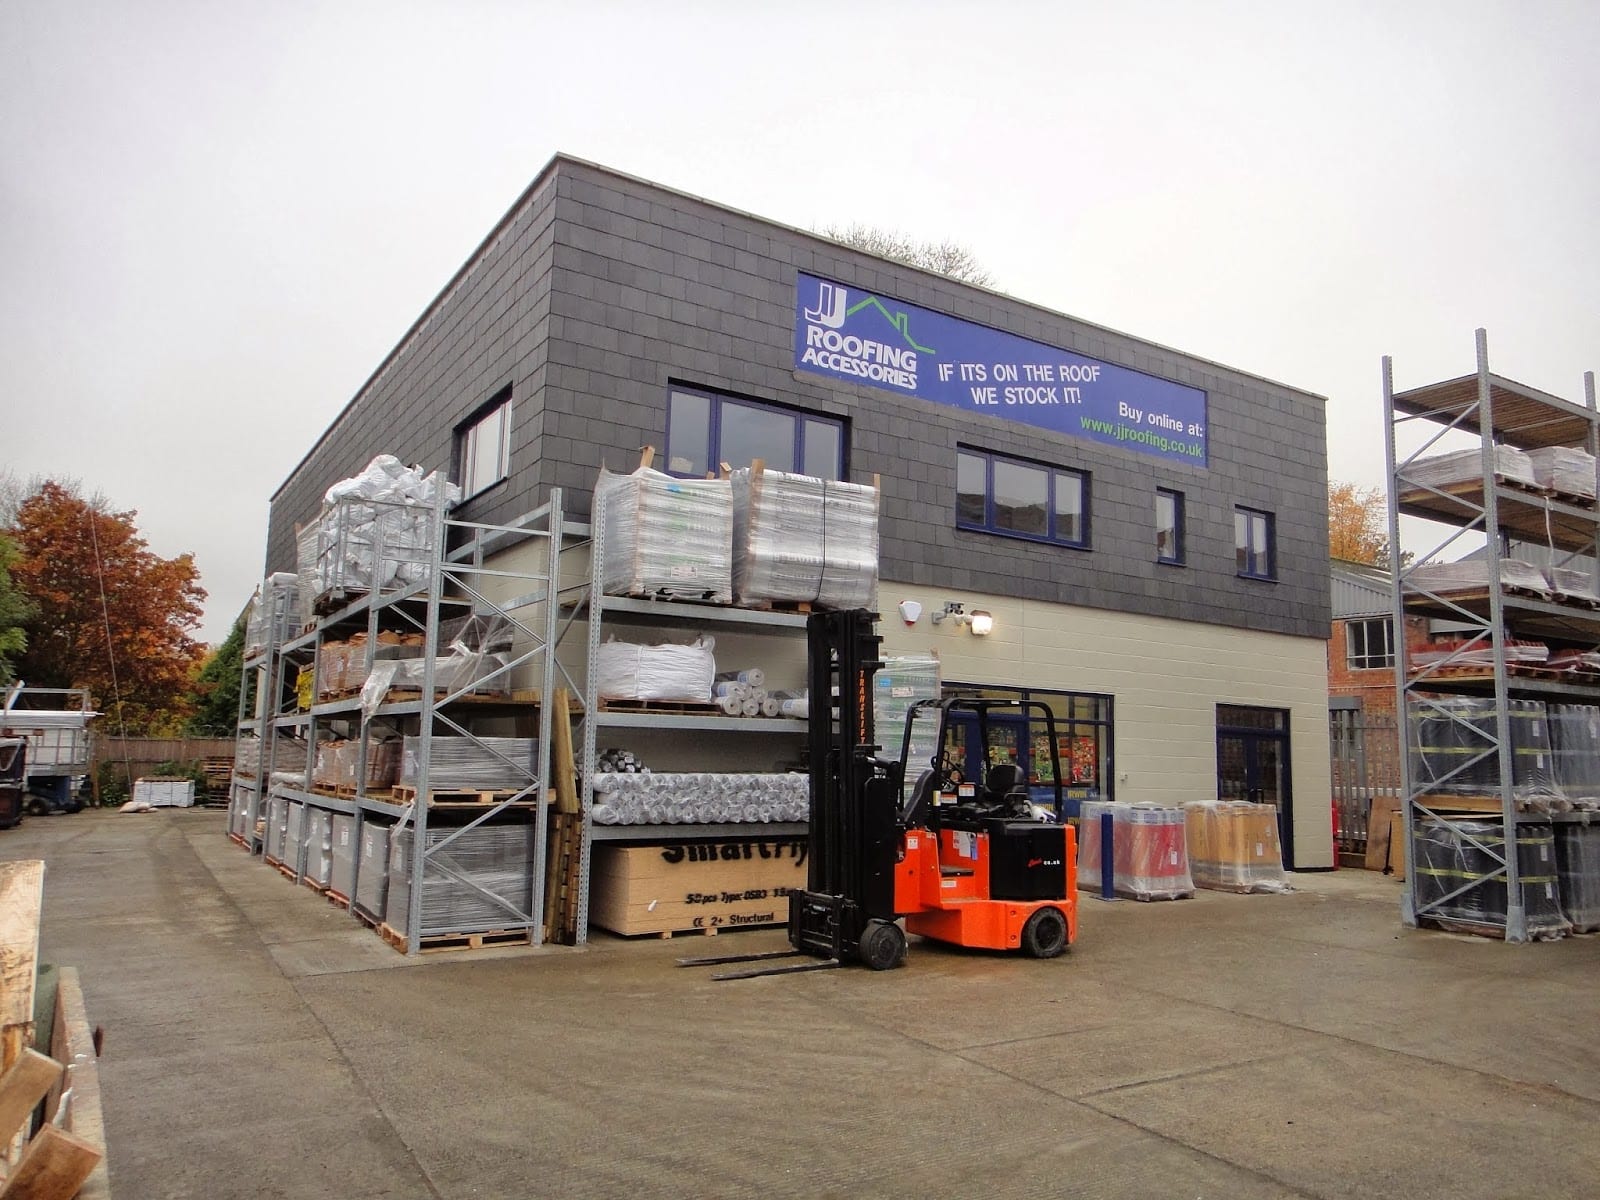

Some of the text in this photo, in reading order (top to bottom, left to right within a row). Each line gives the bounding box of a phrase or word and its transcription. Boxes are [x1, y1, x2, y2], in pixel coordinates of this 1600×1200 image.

[804, 282, 847, 328] JJ
[801, 347, 918, 390] ACCESSORIES
[806, 325, 917, 373] ROOFING
[938, 363, 1101, 383] IF ITS ON THE ROOF
[970, 387, 1082, 405] WE STOCK IT!
[1080, 416, 1203, 458] www.jjroofing.co.uk
[1119, 401, 1204, 438] Buy online at:
[711, 916, 723, 926] 2+
[729, 912, 774, 924] Structural
